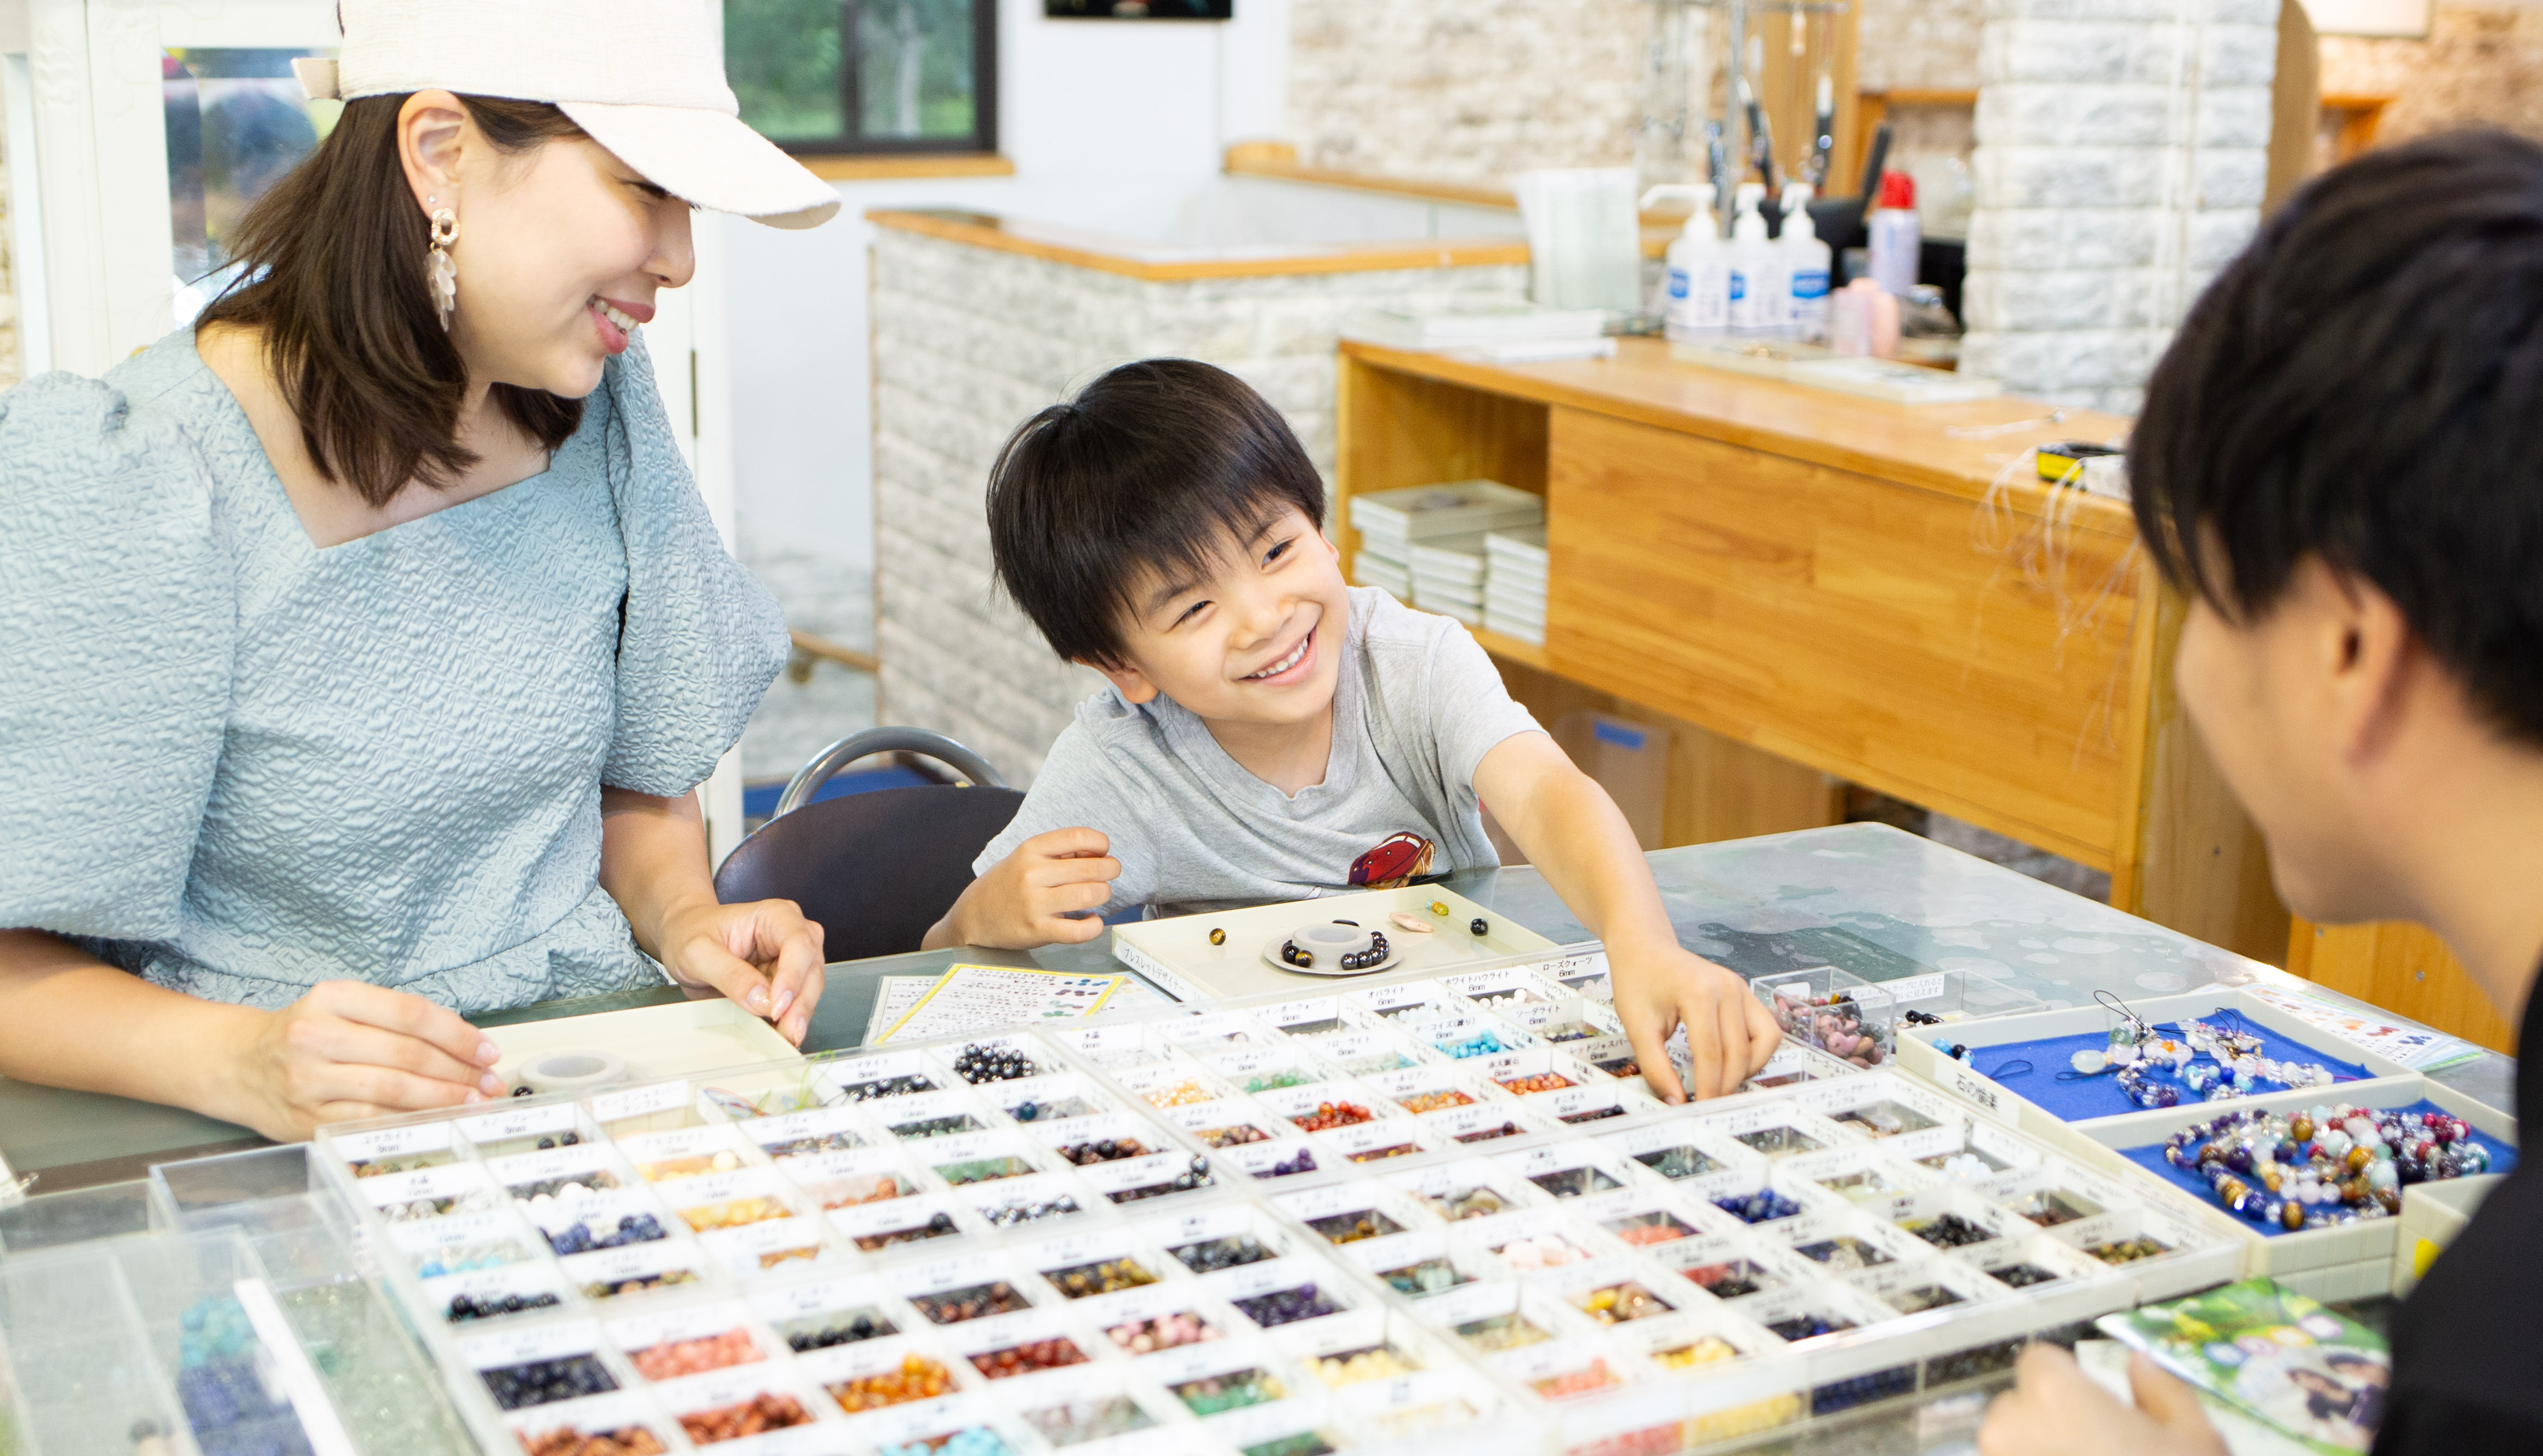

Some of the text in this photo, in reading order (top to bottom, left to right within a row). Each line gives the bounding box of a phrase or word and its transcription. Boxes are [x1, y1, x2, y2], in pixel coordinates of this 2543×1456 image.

[1543, 957, 1592, 971] ローズクォーツ
[1558, 969, 1575, 977] 6mm
[1444, 971, 1510, 986] ホワイトハウライト
[1378, 998, 1395, 1006] 6mm
[1516, 1004, 1561, 1017] ソーダライト
[1282, 1014, 1300, 1022] 6mm
[1529, 1017, 1546, 1025] 6mm
[1436, 1031, 1454, 1039] 6mm
[1337, 1048, 1356, 1056] 6mm
[1494, 1069, 1512, 1077] 6mm
